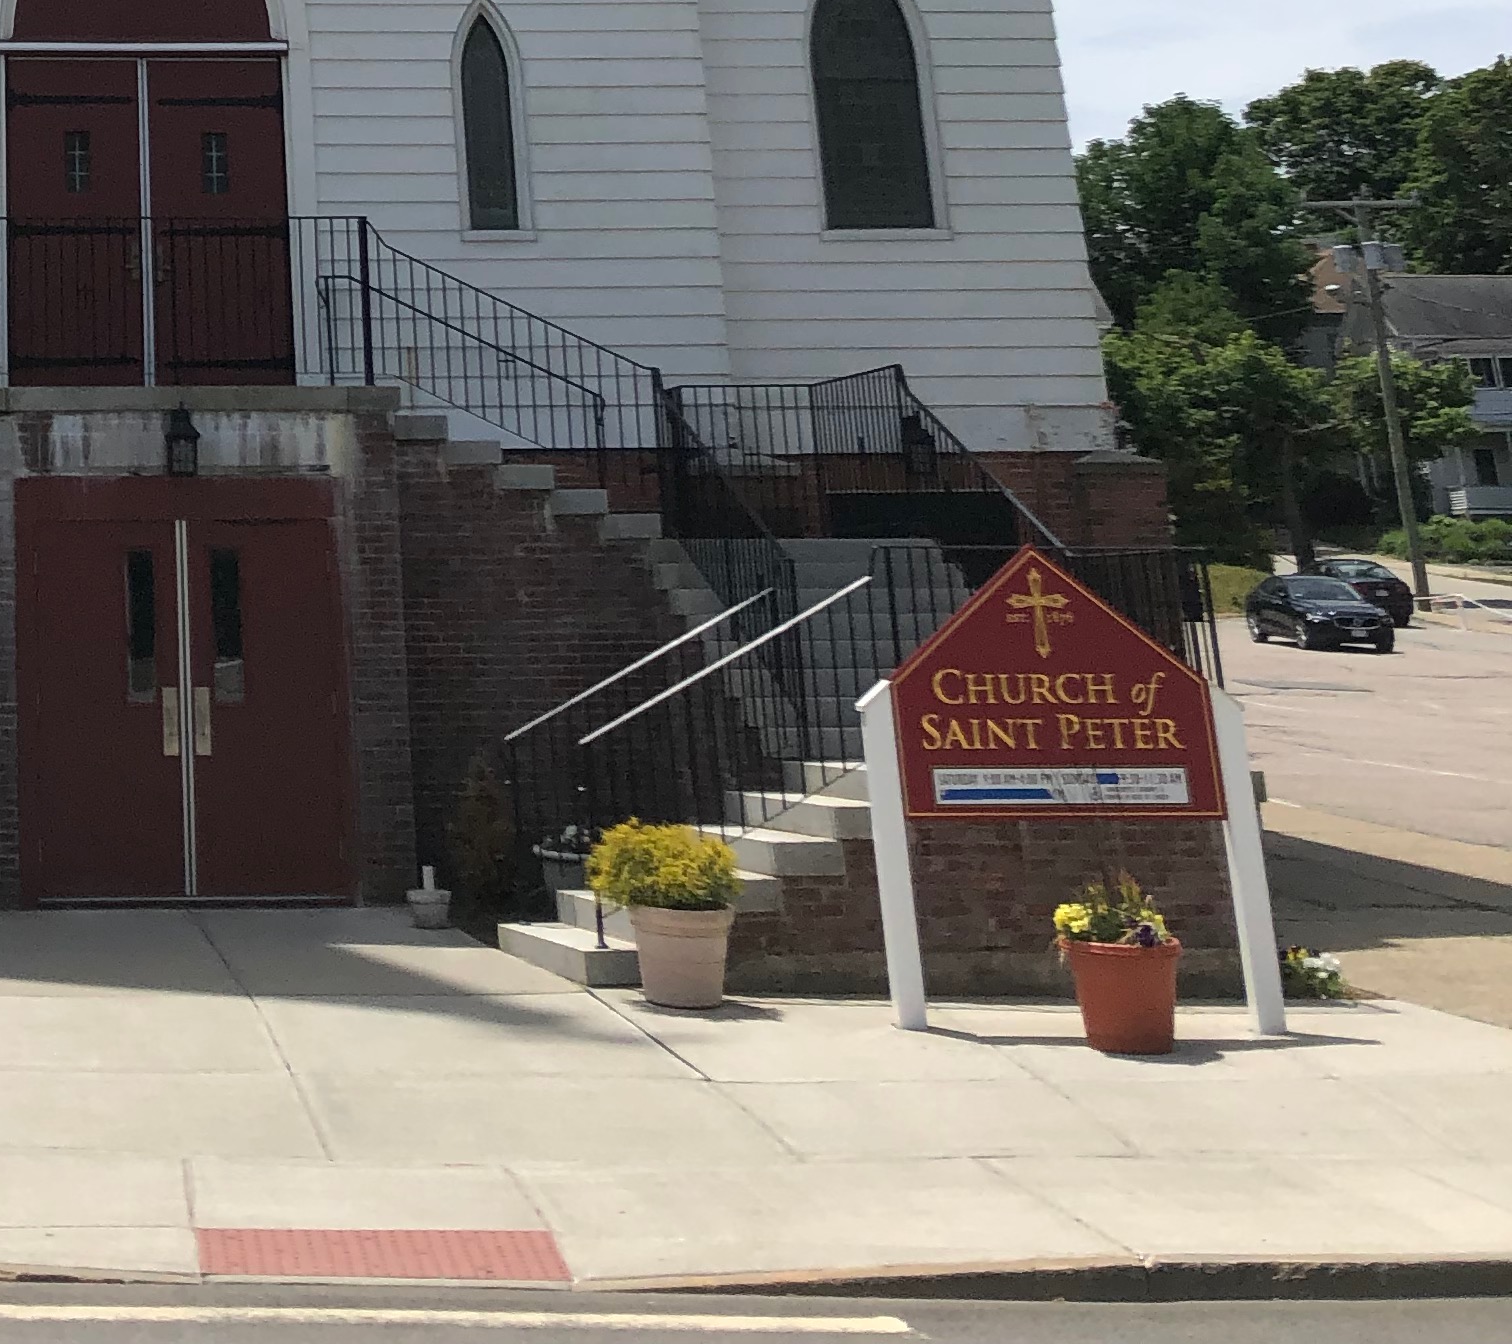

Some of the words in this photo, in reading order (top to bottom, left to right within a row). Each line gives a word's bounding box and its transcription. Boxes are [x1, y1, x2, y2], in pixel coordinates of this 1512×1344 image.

[931, 667, 1121, 705] CHURCH
[1129, 671, 1166, 716] of
[920, 713, 1043, 751] SAINT
[1055, 713, 1188, 750] PETER
